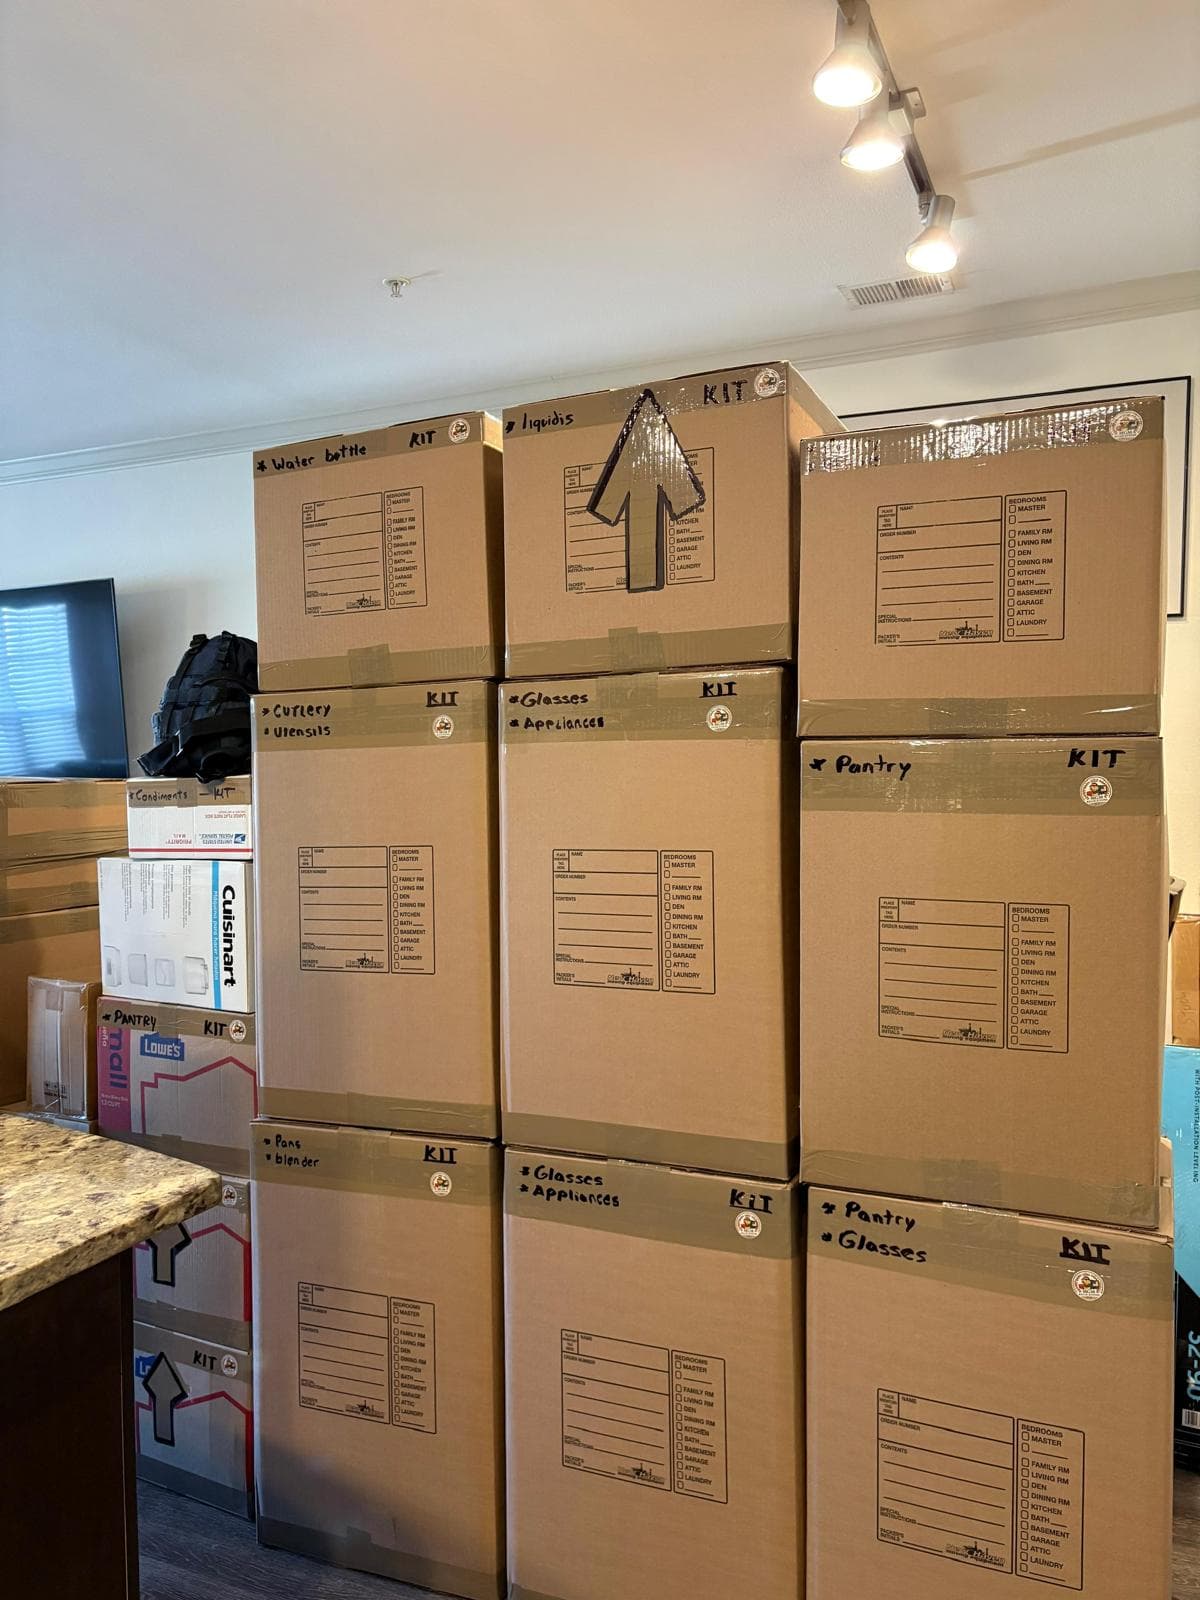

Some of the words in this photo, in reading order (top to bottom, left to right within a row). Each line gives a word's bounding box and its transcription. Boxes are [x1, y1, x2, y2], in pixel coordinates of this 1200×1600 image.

[703, 379, 748, 405] KIT
[409, 430, 436, 448] KIT
[272, 456, 315, 470] Water
[326, 444, 366, 462] bottle
[702, 681, 737, 697] KIT
[427, 691, 459, 707] KIT
[520, 692, 589, 707] Glasses
[1068, 748, 1126, 768] KIT
[836, 754, 911, 780] Pantry
[223, 885, 236, 987] Cuisinart
[114, 1010, 156, 1031] PANTRY
[204, 1020, 227, 1036] KIT
[275, 1134, 301, 1149] Pans
[275, 1153, 319, 1167] blender
[424, 1145, 458, 1164] KIT
[534, 1165, 603, 1186] Glasses
[533, 1186, 619, 1207] Appliances
[845, 1201, 916, 1231] Pantry
[838, 1230, 927, 1262] Glasses
[1059, 1236, 1110, 1265] KIT
[193, 1350, 217, 1370] KIT
[675, 1354, 708, 1365] BEDROOMS
[683, 1364, 707, 1373] MASTER
[685, 1426, 709, 1436] KITCHEN
[1022, 1424, 1063, 1438] BEDROOMS
[1032, 1436, 1062, 1447] MASTER
[685, 1446, 716, 1457] BASEMENT
[685, 1456, 709, 1465] GARAGE
[1032, 1461, 1057, 1472] FAMILY
[685, 1475, 712, 1485] LAUNDRY
[1032, 1472, 1055, 1482] LIVING
[1057, 1477, 1069, 1485] RM
[1032, 1482, 1047, 1491] DEN
[1031, 1493, 1056, 1504] DINING
[1058, 1498, 1070, 1506] RM
[1031, 1504, 1062, 1515] KITCHEN
[1031, 1514, 1050, 1523] BATH
[1031, 1525, 1070, 1538] BASEMENT
[1031, 1535, 1060, 1547] GARAGE
[1030, 1546, 1051, 1555] ATTIC
[1030, 1557, 1064, 1569] LAUNDRY
